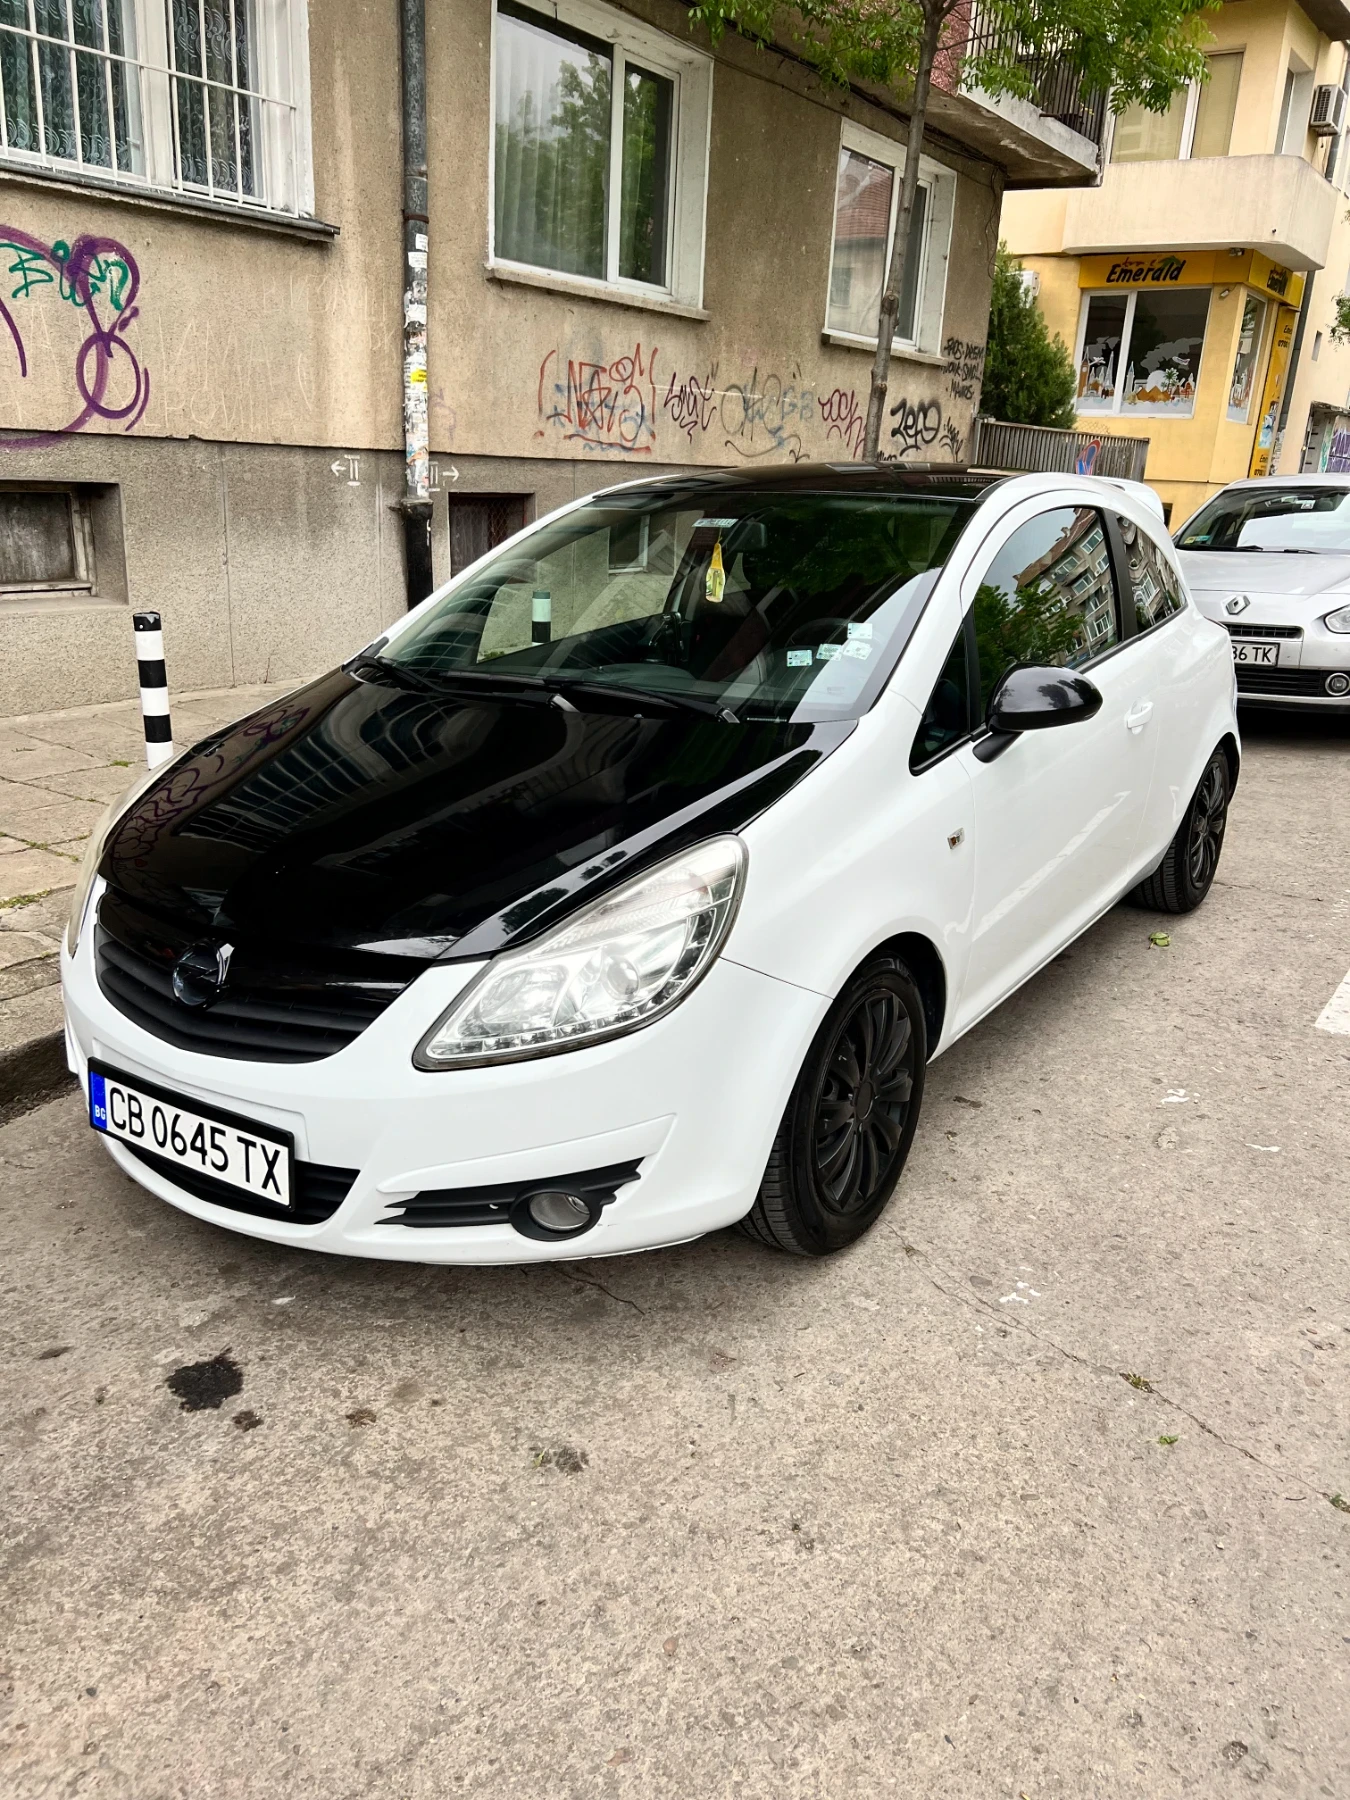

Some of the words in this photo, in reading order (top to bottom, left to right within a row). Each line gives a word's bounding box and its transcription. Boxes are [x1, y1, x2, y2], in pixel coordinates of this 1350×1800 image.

[1106, 259, 1186, 283] Emerald
[1252, 647, 1273, 662] TK
[95, 1104, 106, 1120] BG
[109, 1087, 145, 1138] CB
[152, 1105, 229, 1172] 0645
[237, 1135, 282, 1196] TX
